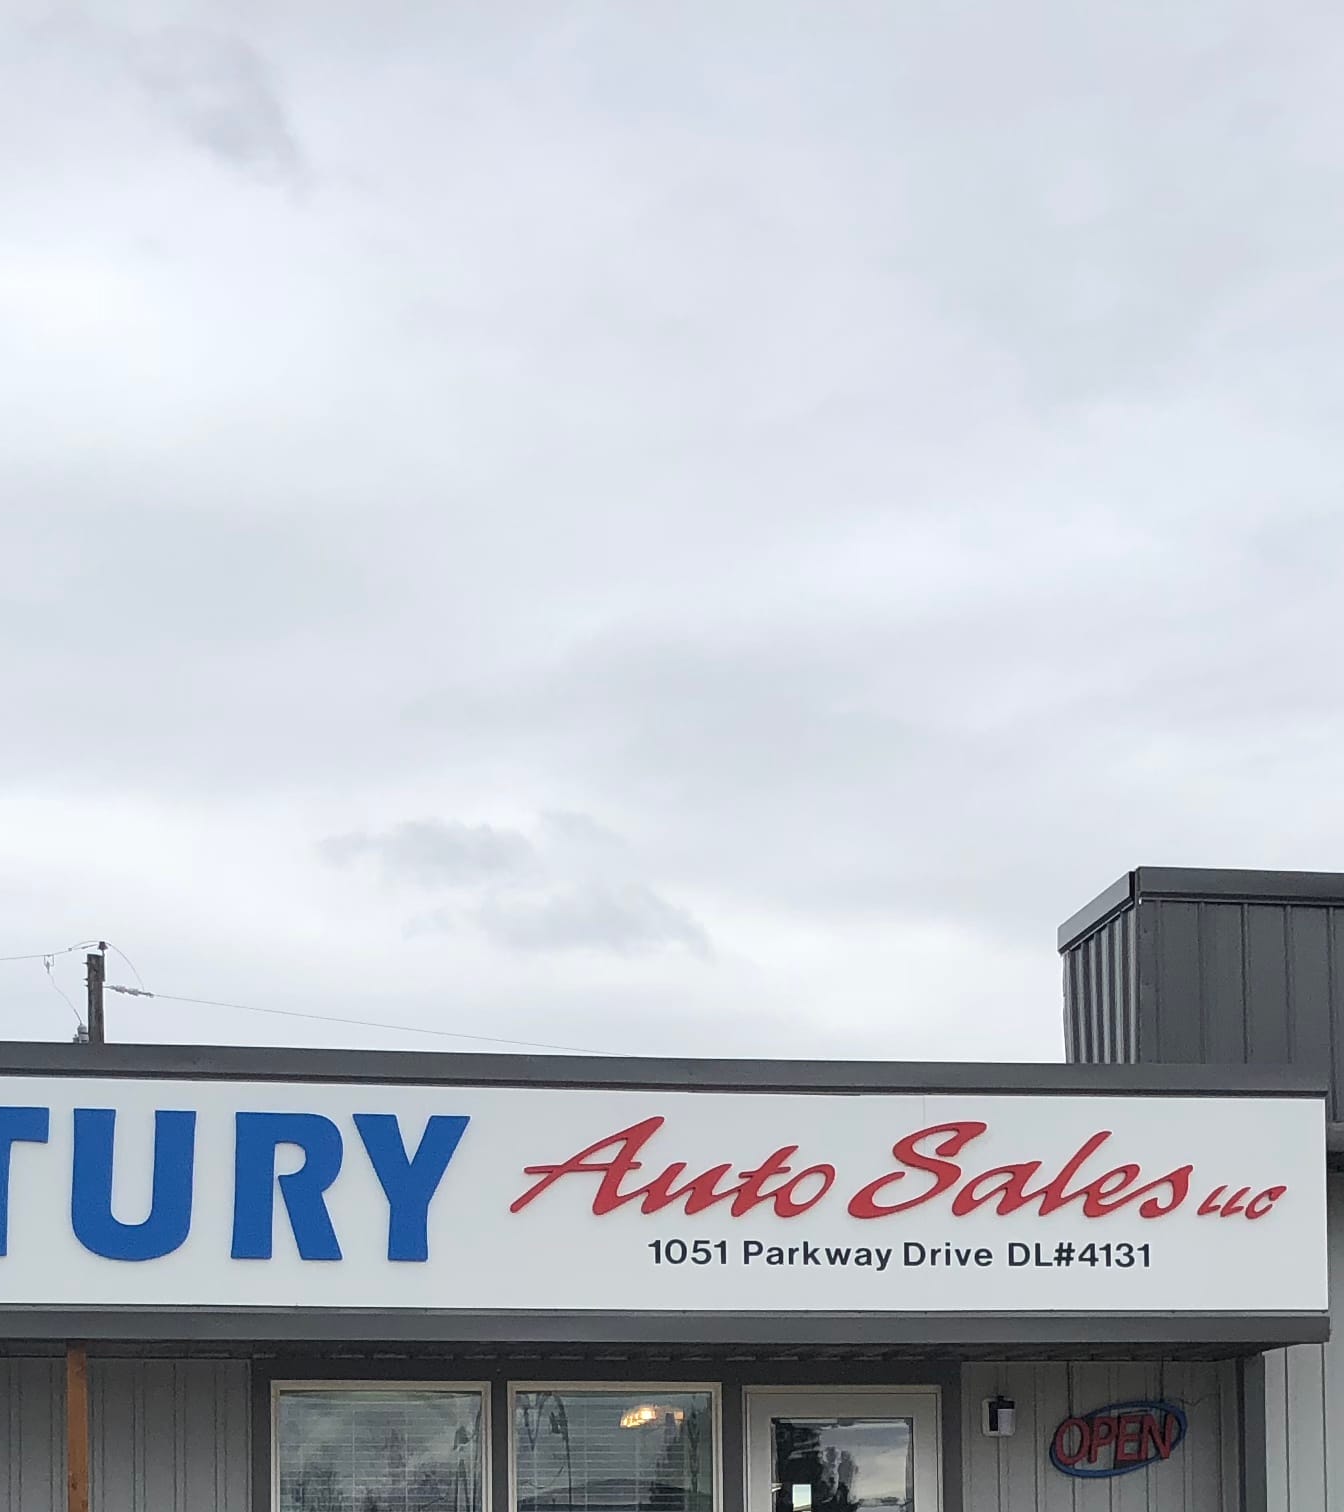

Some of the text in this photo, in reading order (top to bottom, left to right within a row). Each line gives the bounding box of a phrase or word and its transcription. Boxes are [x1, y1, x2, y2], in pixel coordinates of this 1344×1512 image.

[510, 1115, 836, 1219] Auto
[846, 1121, 1194, 1220] Sales
[1197, 1184, 1287, 1220] LLC
[647, 1239, 1152, 1272] 1051 Parkway Drive DL#4131
[1055, 1414, 1174, 1465] OPEN
